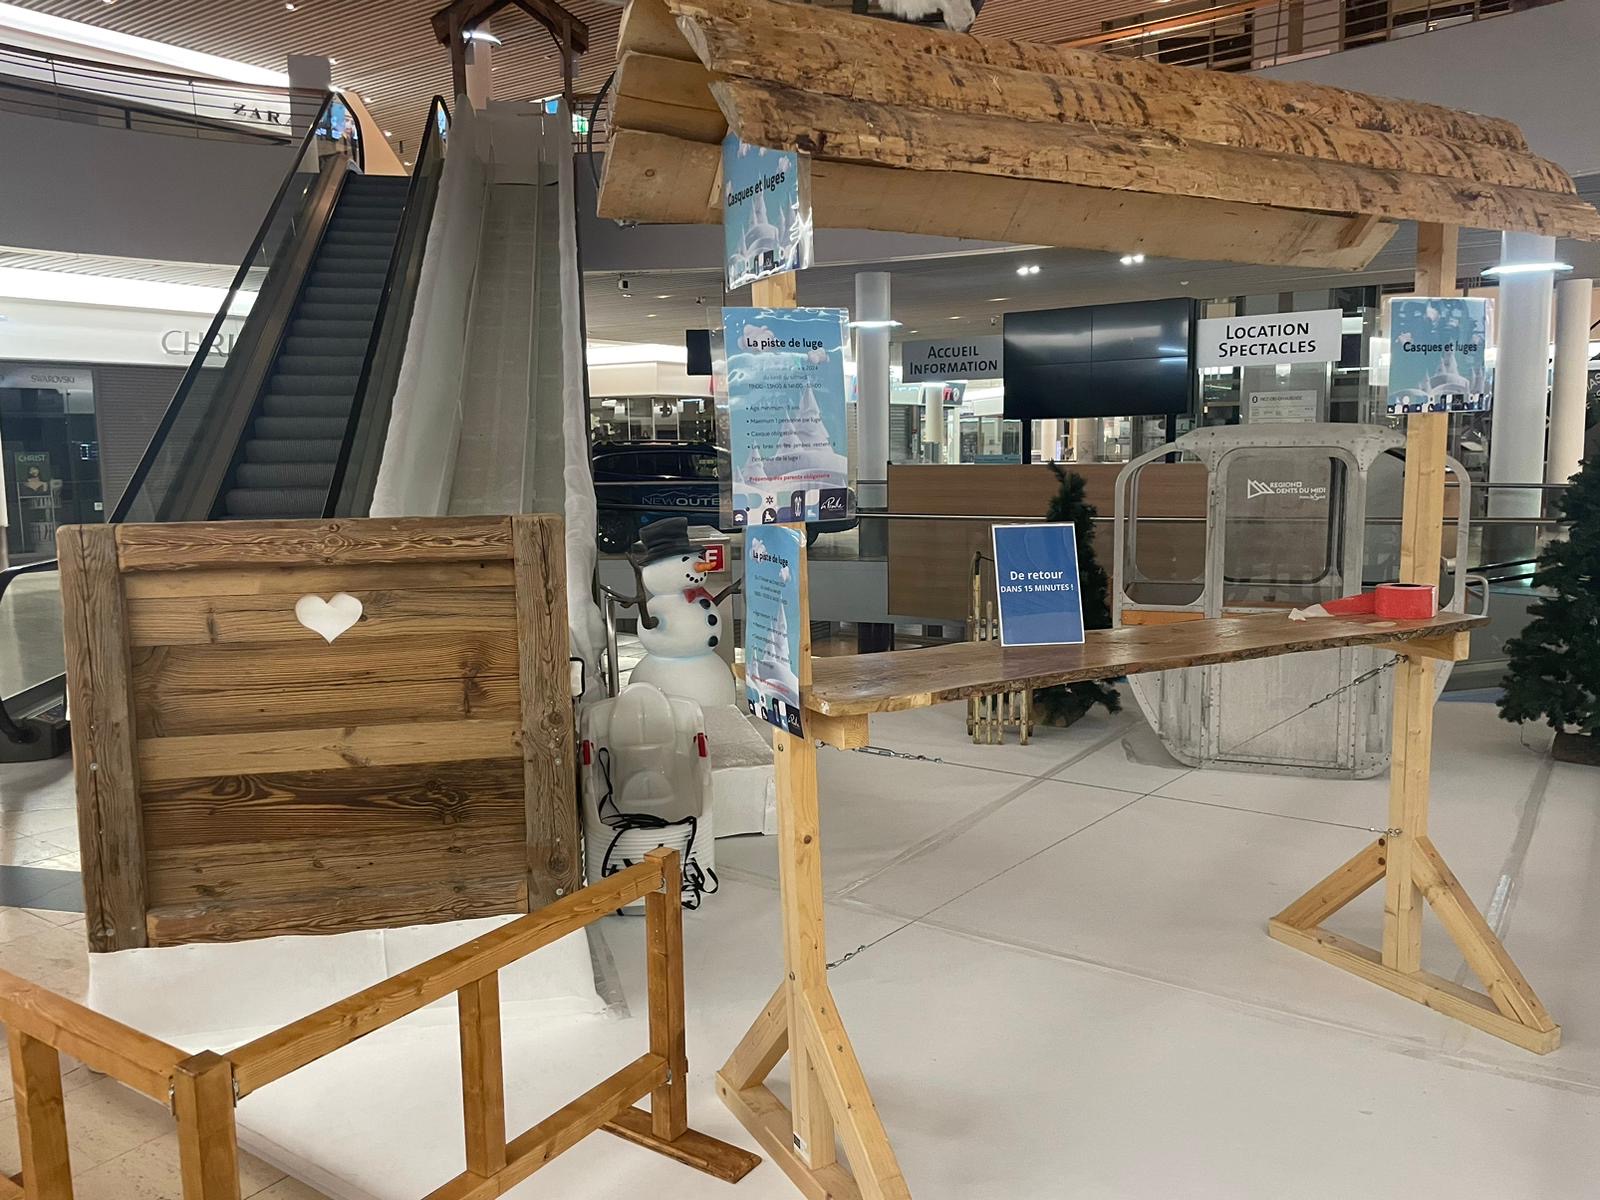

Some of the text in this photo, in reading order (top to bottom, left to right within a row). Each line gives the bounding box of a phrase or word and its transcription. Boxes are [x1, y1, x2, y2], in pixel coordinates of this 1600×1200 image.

[233, 102, 291, 126] ZAR
[728, 171, 785, 207] Casques et luges
[1226, 322, 1309, 340] LOCATION
[162, 330, 234, 357] CHRI
[747, 338, 823, 350] La piste de luge
[1219, 340, 1316, 358] SPECTACLES
[1403, 341, 1478, 356] Casques et luges
[928, 345, 979, 359] ACCUEIL
[910, 360, 998, 375] INFORMATION
[753, 550, 758, 559] La
[772, 554, 778, 564] de
[778, 556, 788, 568] luge
[1010, 571, 1064, 580] De retour
[1001, 585, 1022, 593] DANS
[1035, 583, 1070, 592] MINUTES
